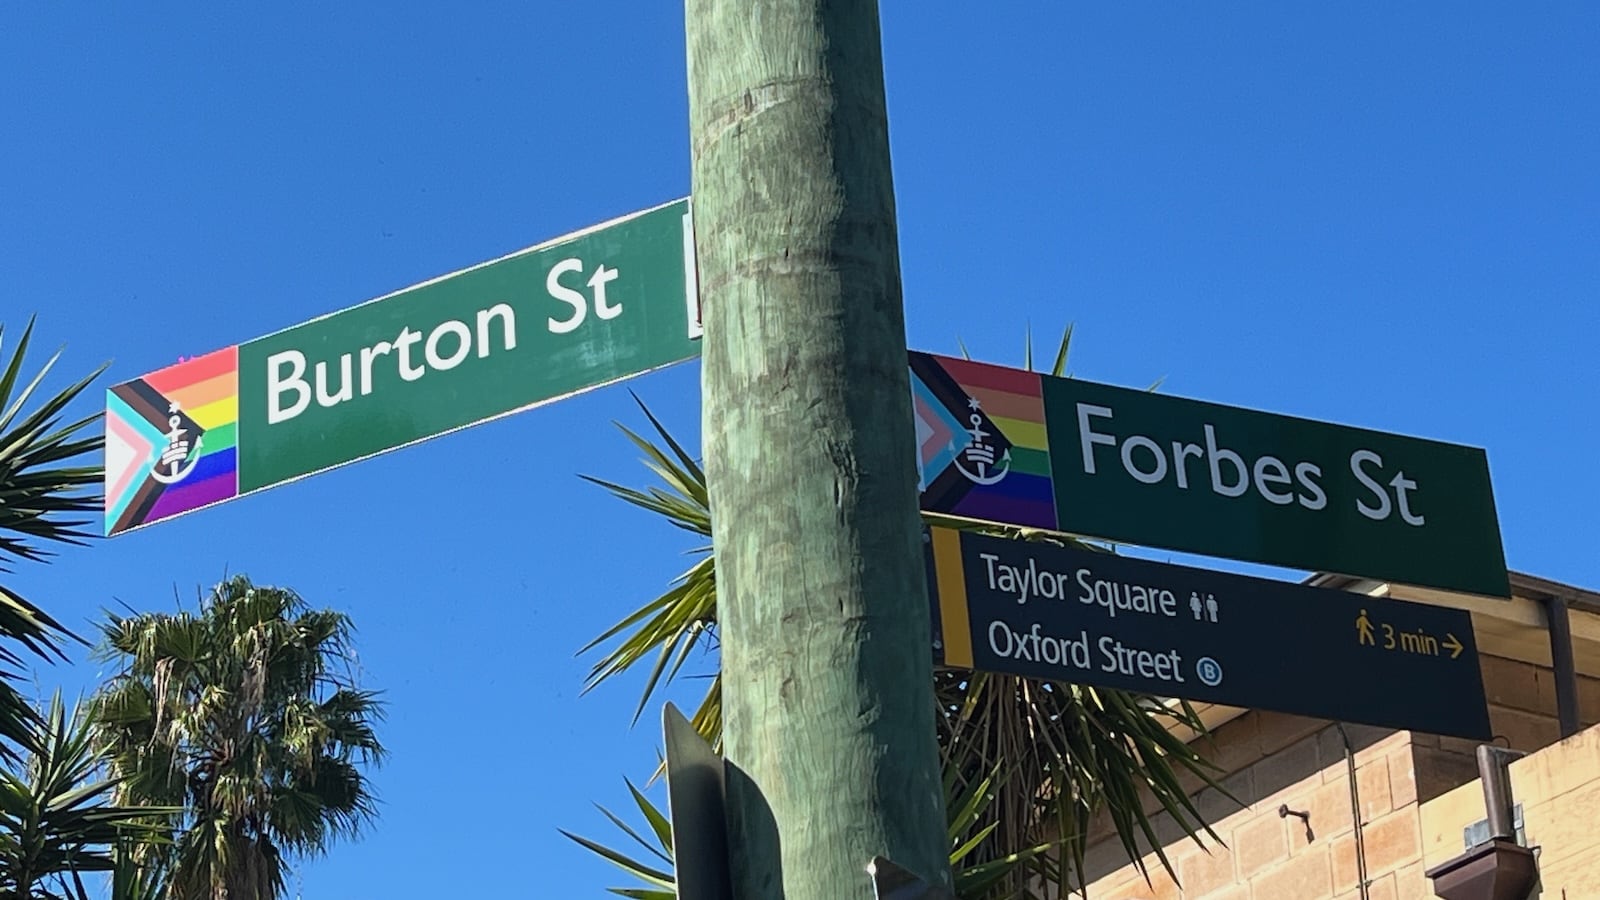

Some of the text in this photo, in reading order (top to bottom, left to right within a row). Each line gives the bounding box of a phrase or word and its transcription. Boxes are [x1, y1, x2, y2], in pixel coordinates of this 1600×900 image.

[267, 258, 622, 424] Burton St
[1076, 402, 1424, 526] Forbes St
[980, 554, 1176, 617] Taylor Square
[988, 621, 1091, 669] Oxford
[1100, 636, 1184, 684] Street
[1381, 623, 1439, 656] 3 min
